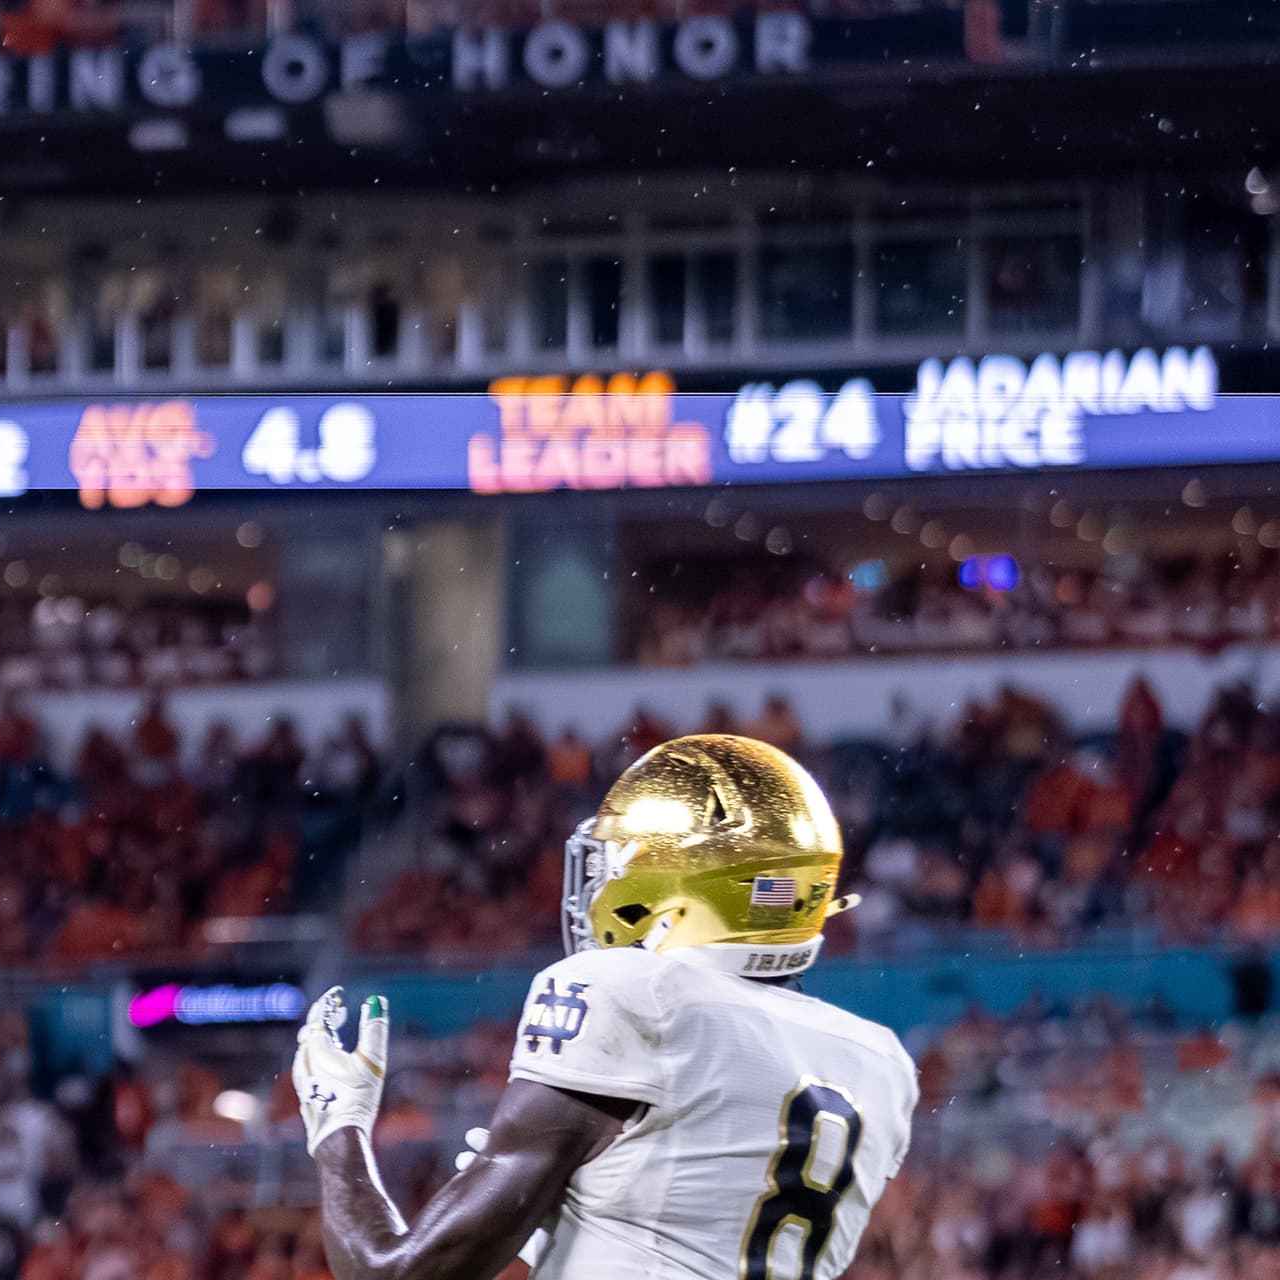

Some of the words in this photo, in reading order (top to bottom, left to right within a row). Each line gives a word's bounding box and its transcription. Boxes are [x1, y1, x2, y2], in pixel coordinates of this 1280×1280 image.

[261, 34, 388, 104] OF
[452, 11, 814, 91] HONOR
[487, 371, 676, 437] TEAM
[917, 346, 1218, 415] JADARIAN
[243, 403, 376, 483] 4.8
[726, 378, 880, 463] #24
[903, 398, 1085, 470] PRICE
[467, 421, 712, 494] LEADER
